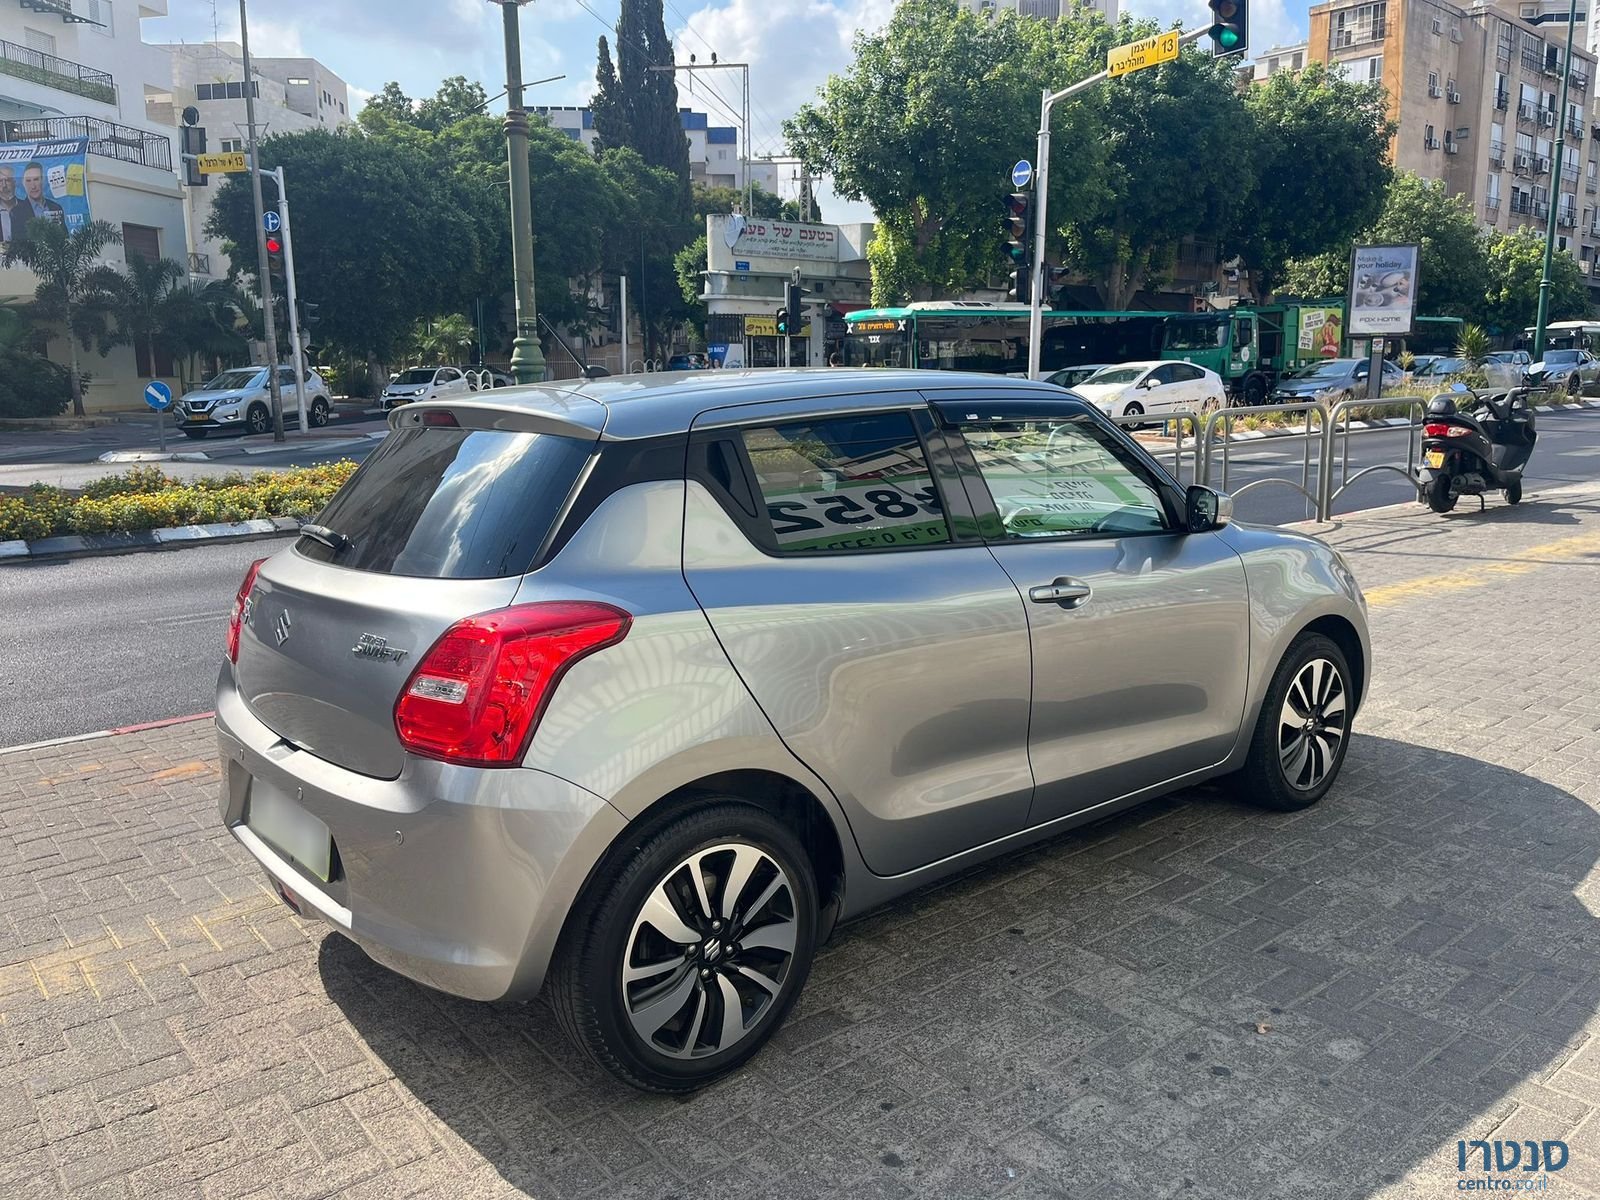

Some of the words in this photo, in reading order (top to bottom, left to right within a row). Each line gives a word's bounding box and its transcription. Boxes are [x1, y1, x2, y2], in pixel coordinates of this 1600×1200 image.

[1161, 38, 1174, 54] 13
[1115, 55, 1145, 70] מוהליבר
[36, 142, 79, 156] התוצאות
[234, 156, 243, 167] 13
[772, 223, 793, 238] של
[799, 228, 834, 242] בטעם
[1357, 262, 1374, 270] your
[1375, 260, 1402, 270] holiday
[351, 642, 409, 664] SWIFT
